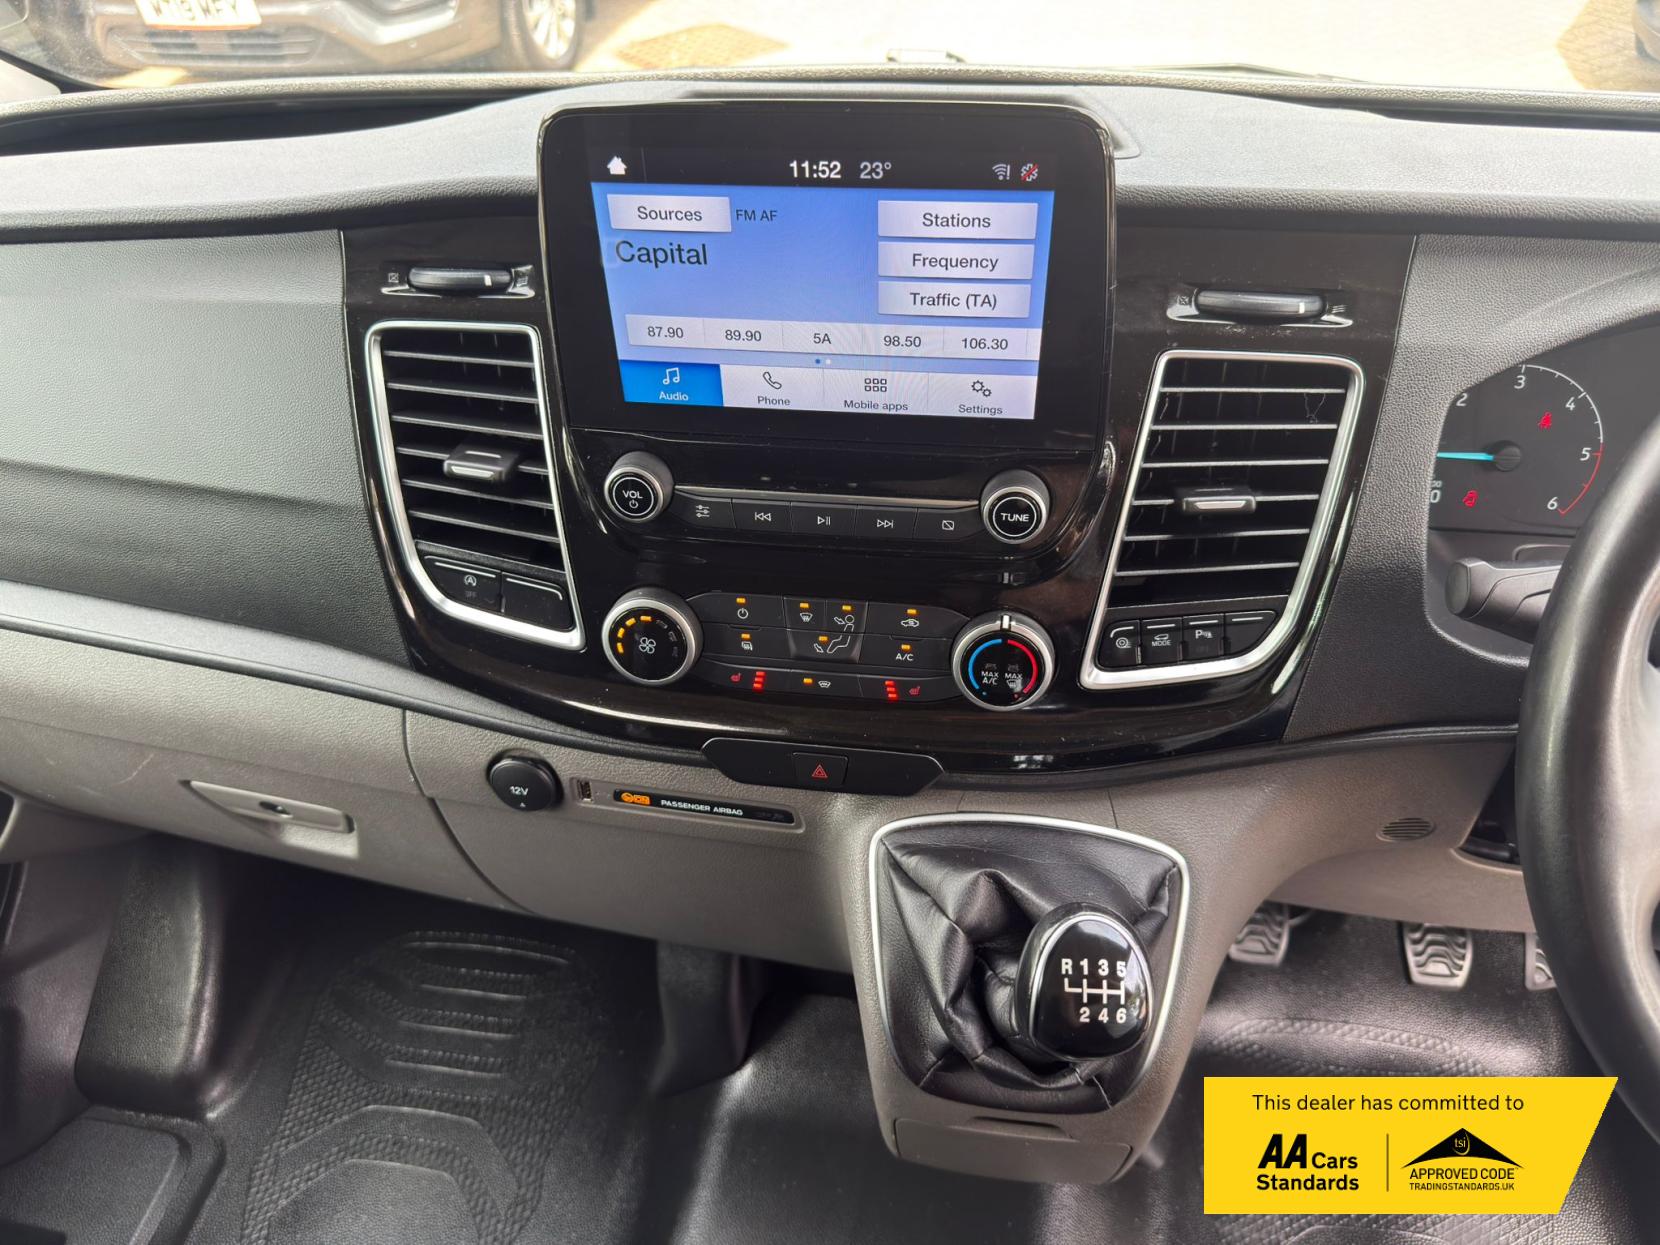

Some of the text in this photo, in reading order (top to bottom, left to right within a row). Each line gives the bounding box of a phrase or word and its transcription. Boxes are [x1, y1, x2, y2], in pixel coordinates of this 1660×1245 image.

[789, 160, 842, 178] 11:52
[637, 206, 703, 221] Sources
[736, 209, 778, 221] FM AF
[922, 212, 992, 228] Stations
[615, 240, 708, 269] Capital
[912, 253, 999, 272] Frequency
[910, 292, 998, 310] Traffic (TA)
[647, 326, 684, 338] 87.90
[725, 329, 762, 342] 89.90
[883, 335, 922, 348] 98.50
[961, 337, 1009, 350] 106.30
[1514, 375, 1526, 390] 3
[659, 390, 689, 401] Audio
[757, 395, 791, 406] Phone
[1456, 393, 1468, 407] 2
[844, 400, 908, 411] Mobile apps
[958, 404, 1003, 416] Settings
[1565, 397, 1576, 411] 4
[1580, 447, 1592, 461] 5
[622, 489, 643, 499] VOL
[1430, 489, 1441, 504] 0
[1547, 496, 1559, 511] 6
[1000, 512, 1030, 522] TUNE
[1151, 639, 1171, 647] MODE
[895, 652, 914, 662] A/C
[981, 670, 999, 678] MAX
[982, 676, 998, 686] A/C
[1004, 672, 1023, 680] MAX
[509, 785, 529, 796] 12V
[660, 799, 711, 812] PASSENGER
[713, 806, 743, 816] AIRBAG
[1061, 958, 1126, 978] R 1 3 5
[1079, 1006, 1127, 1024] 2 4 6
